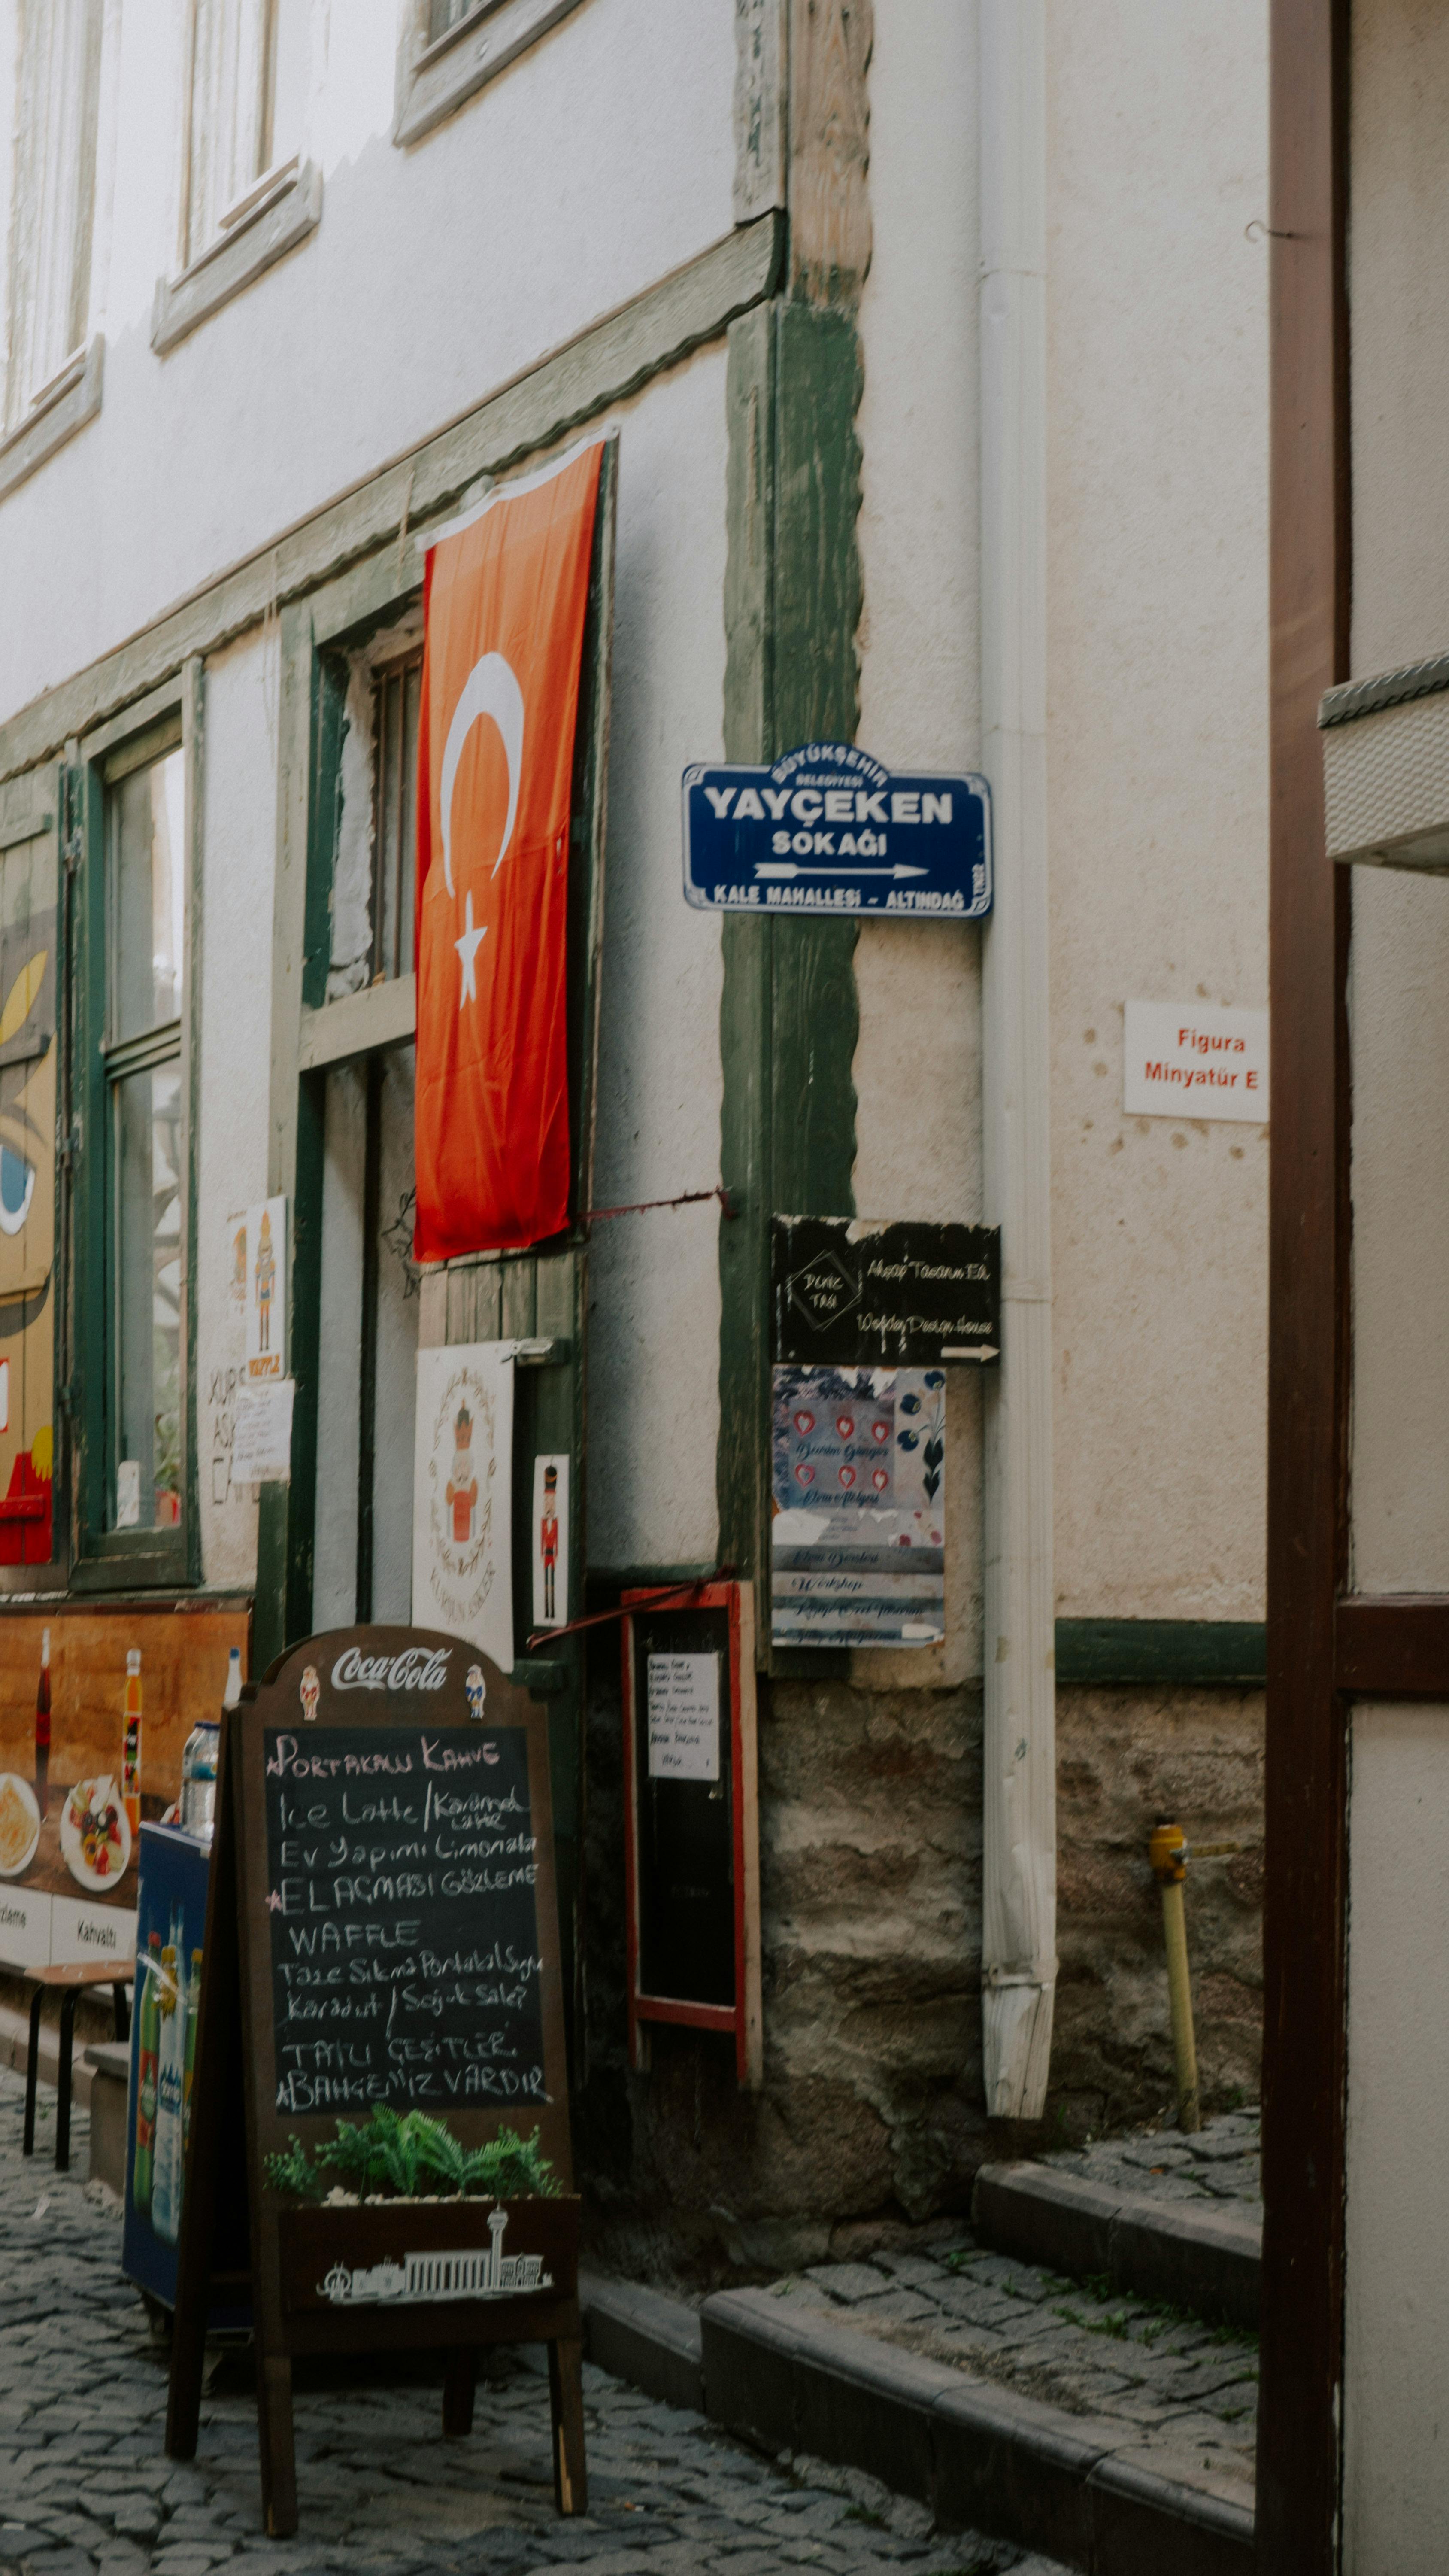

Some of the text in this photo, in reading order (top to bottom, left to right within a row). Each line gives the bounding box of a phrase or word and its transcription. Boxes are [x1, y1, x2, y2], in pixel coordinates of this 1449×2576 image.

[704, 787, 953, 828] YAYÇEKEN
[772, 829, 887, 857] SOKAĞI
[714, 884, 760, 903] KALE
[767, 886, 861, 907] MAHALLESİ
[885, 888, 964, 911] ALTINDAĞ
[1178, 1029, 1246, 1054] Figura
[1145, 1062, 1238, 1089] Minyatür
[331, 1646, 453, 1691] Coca-Cola
[280, 1792, 331, 1832] Ice
[281, 1840, 319, 1868] Ev
[289, 1920, 421, 1956] WAFFLE
[443, 2063, 555, 2104] VARDIR
